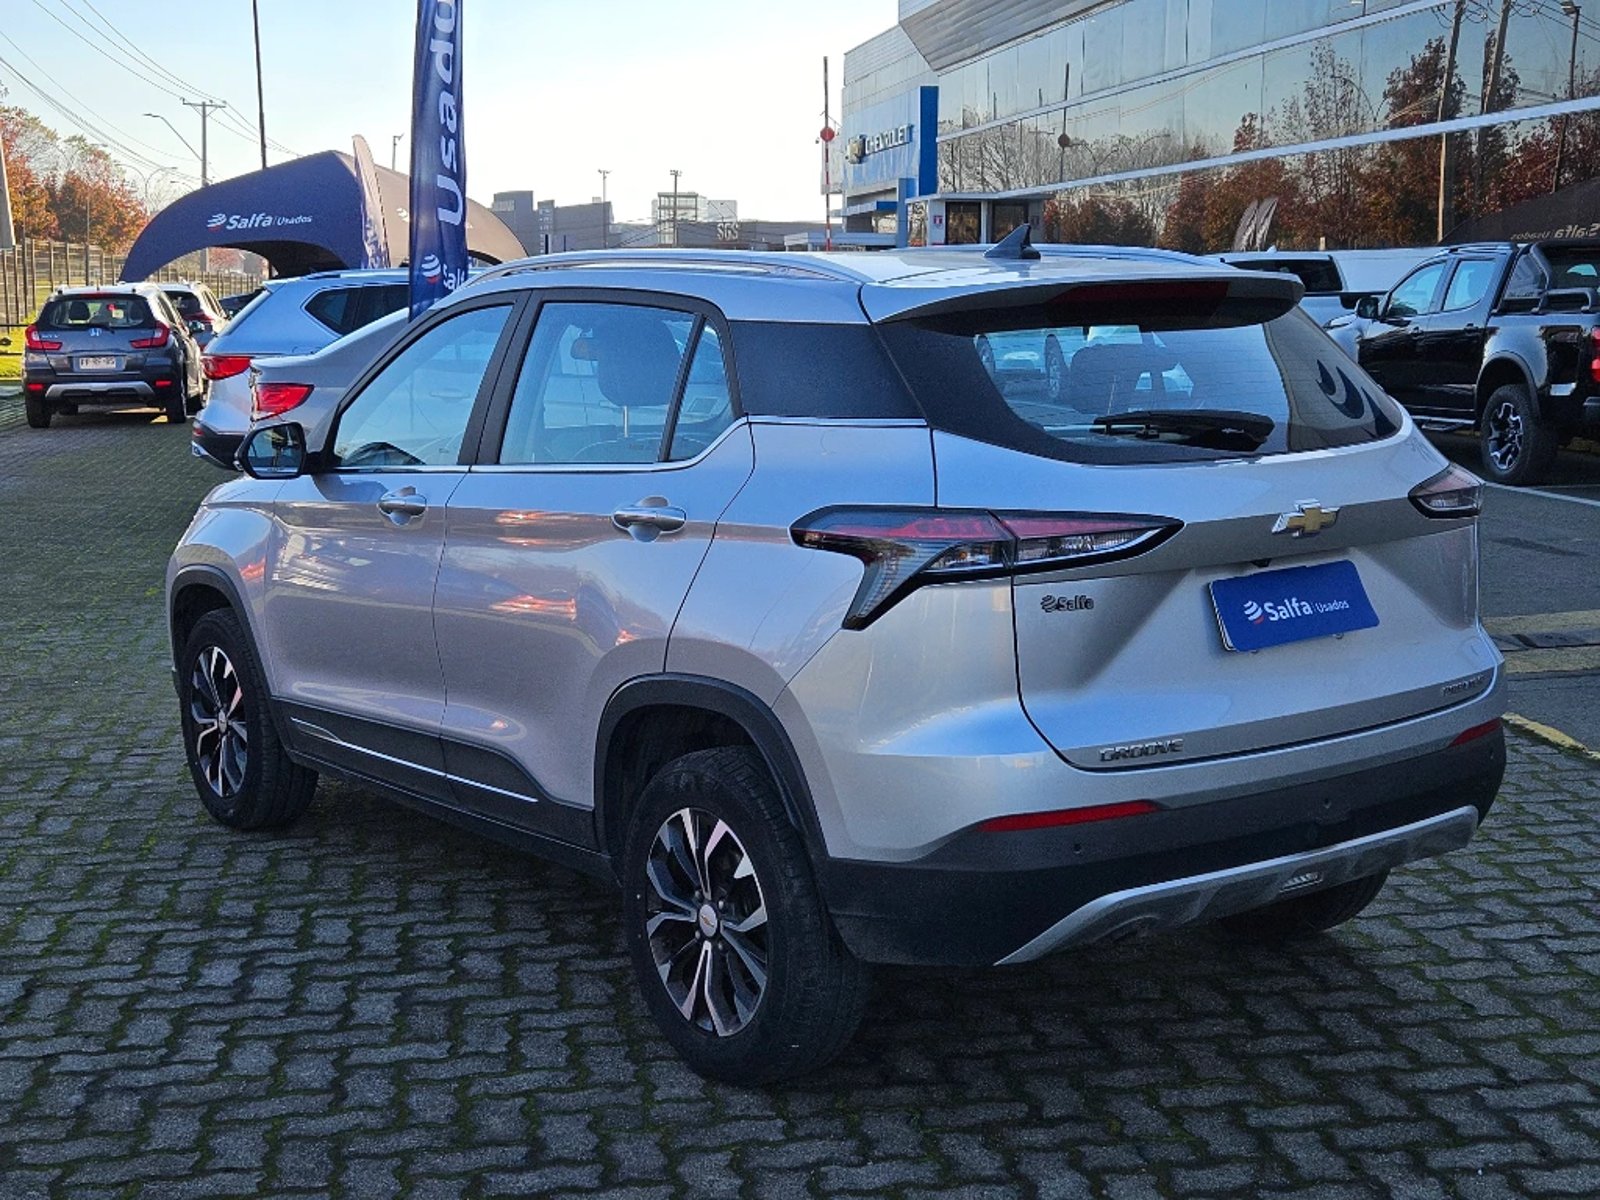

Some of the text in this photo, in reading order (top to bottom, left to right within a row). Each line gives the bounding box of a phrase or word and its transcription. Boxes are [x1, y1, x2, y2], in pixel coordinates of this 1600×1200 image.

[865, 124, 914, 155] CHEVROLET
[226, 212, 313, 230] Salfa Usados
[717, 222, 739, 241] SGS
[1057, 594, 1094, 611] Salfa
[1263, 597, 1350, 622] Salfa Usados
[1099, 738, 1184, 762] GROOVE
